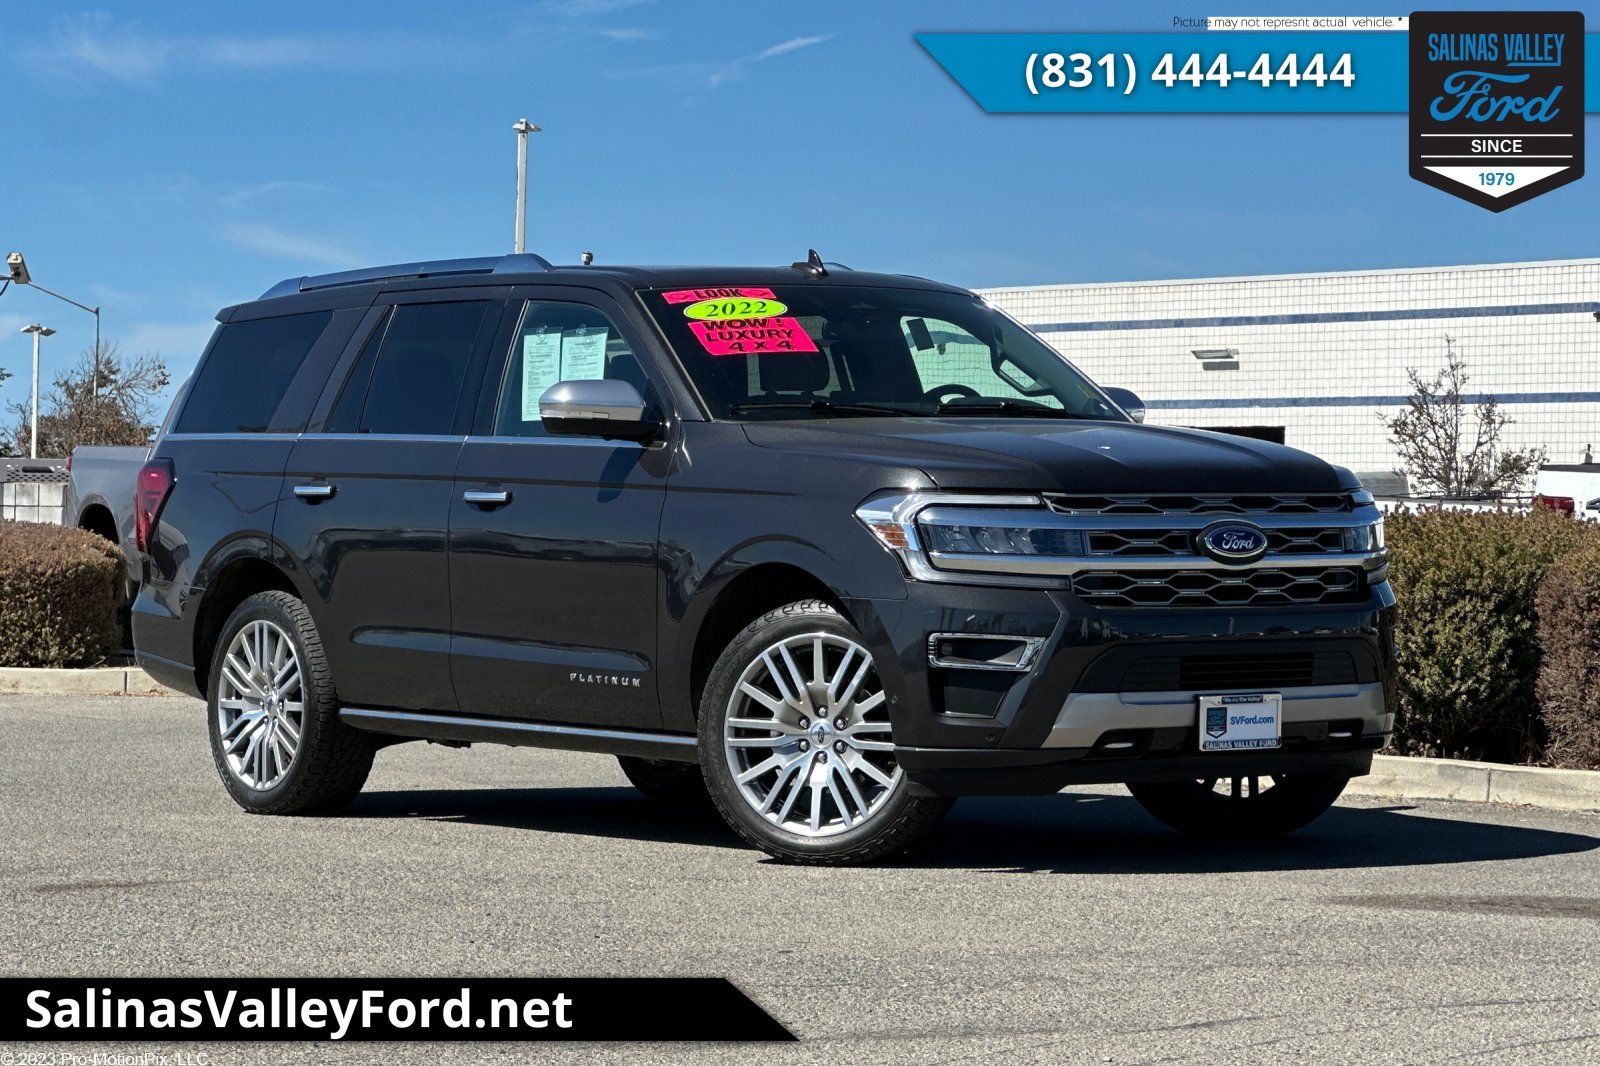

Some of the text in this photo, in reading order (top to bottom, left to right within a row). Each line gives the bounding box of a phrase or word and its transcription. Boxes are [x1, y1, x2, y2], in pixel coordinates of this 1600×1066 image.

[694, 288, 743, 300] LOOK
[706, 301, 768, 317] 2022
[705, 328, 795, 343] LUXURY
[1221, 531, 1255, 550] Ford
[569, 672, 641, 688] PLATINUM
[1230, 715, 1275, 725] SVFord.com
[1205, 739, 1277, 749] SALINAS VALLEY FORD
